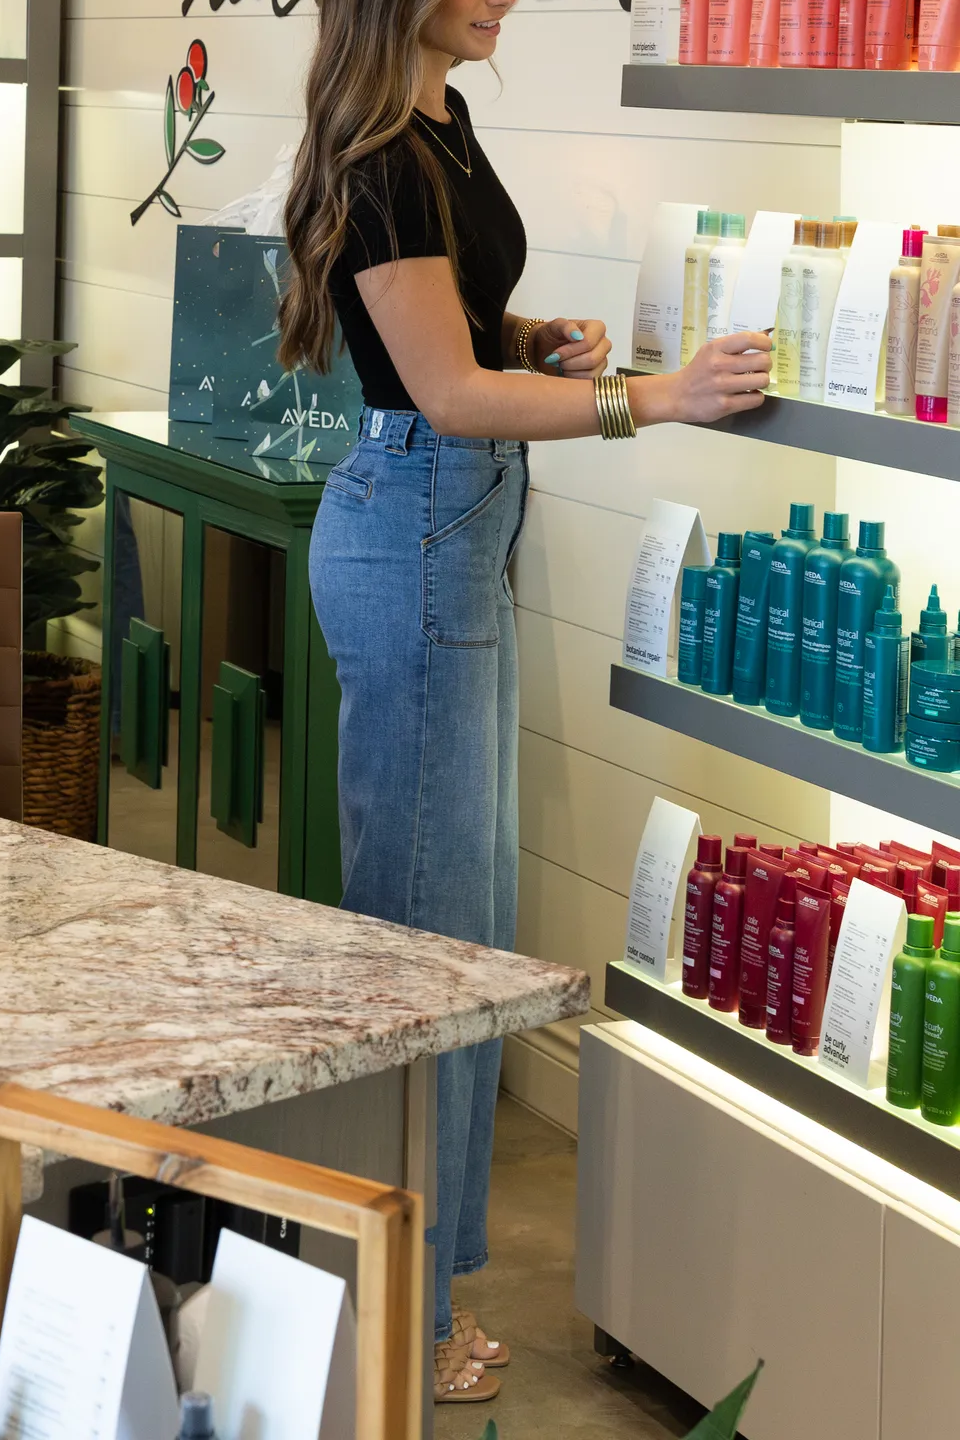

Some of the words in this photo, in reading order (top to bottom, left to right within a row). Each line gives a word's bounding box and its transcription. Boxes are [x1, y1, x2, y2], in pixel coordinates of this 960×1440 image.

[635, 345, 663, 358] shampure
[828, 380, 846, 394] cherry
[846, 383, 868, 396] almond
[281, 407, 350, 431] AVEDA
[625, 643, 647, 658] botanical
[646, 651, 661, 662] repair
[744, 923, 759, 935] control
[747, 916, 759, 926] color
[627, 945, 639, 957] color
[638, 951, 655, 966] control
[824, 1032, 832, 1045] be
[832, 1039, 847, 1054] curly
[823, 1044, 850, 1065] advanced
